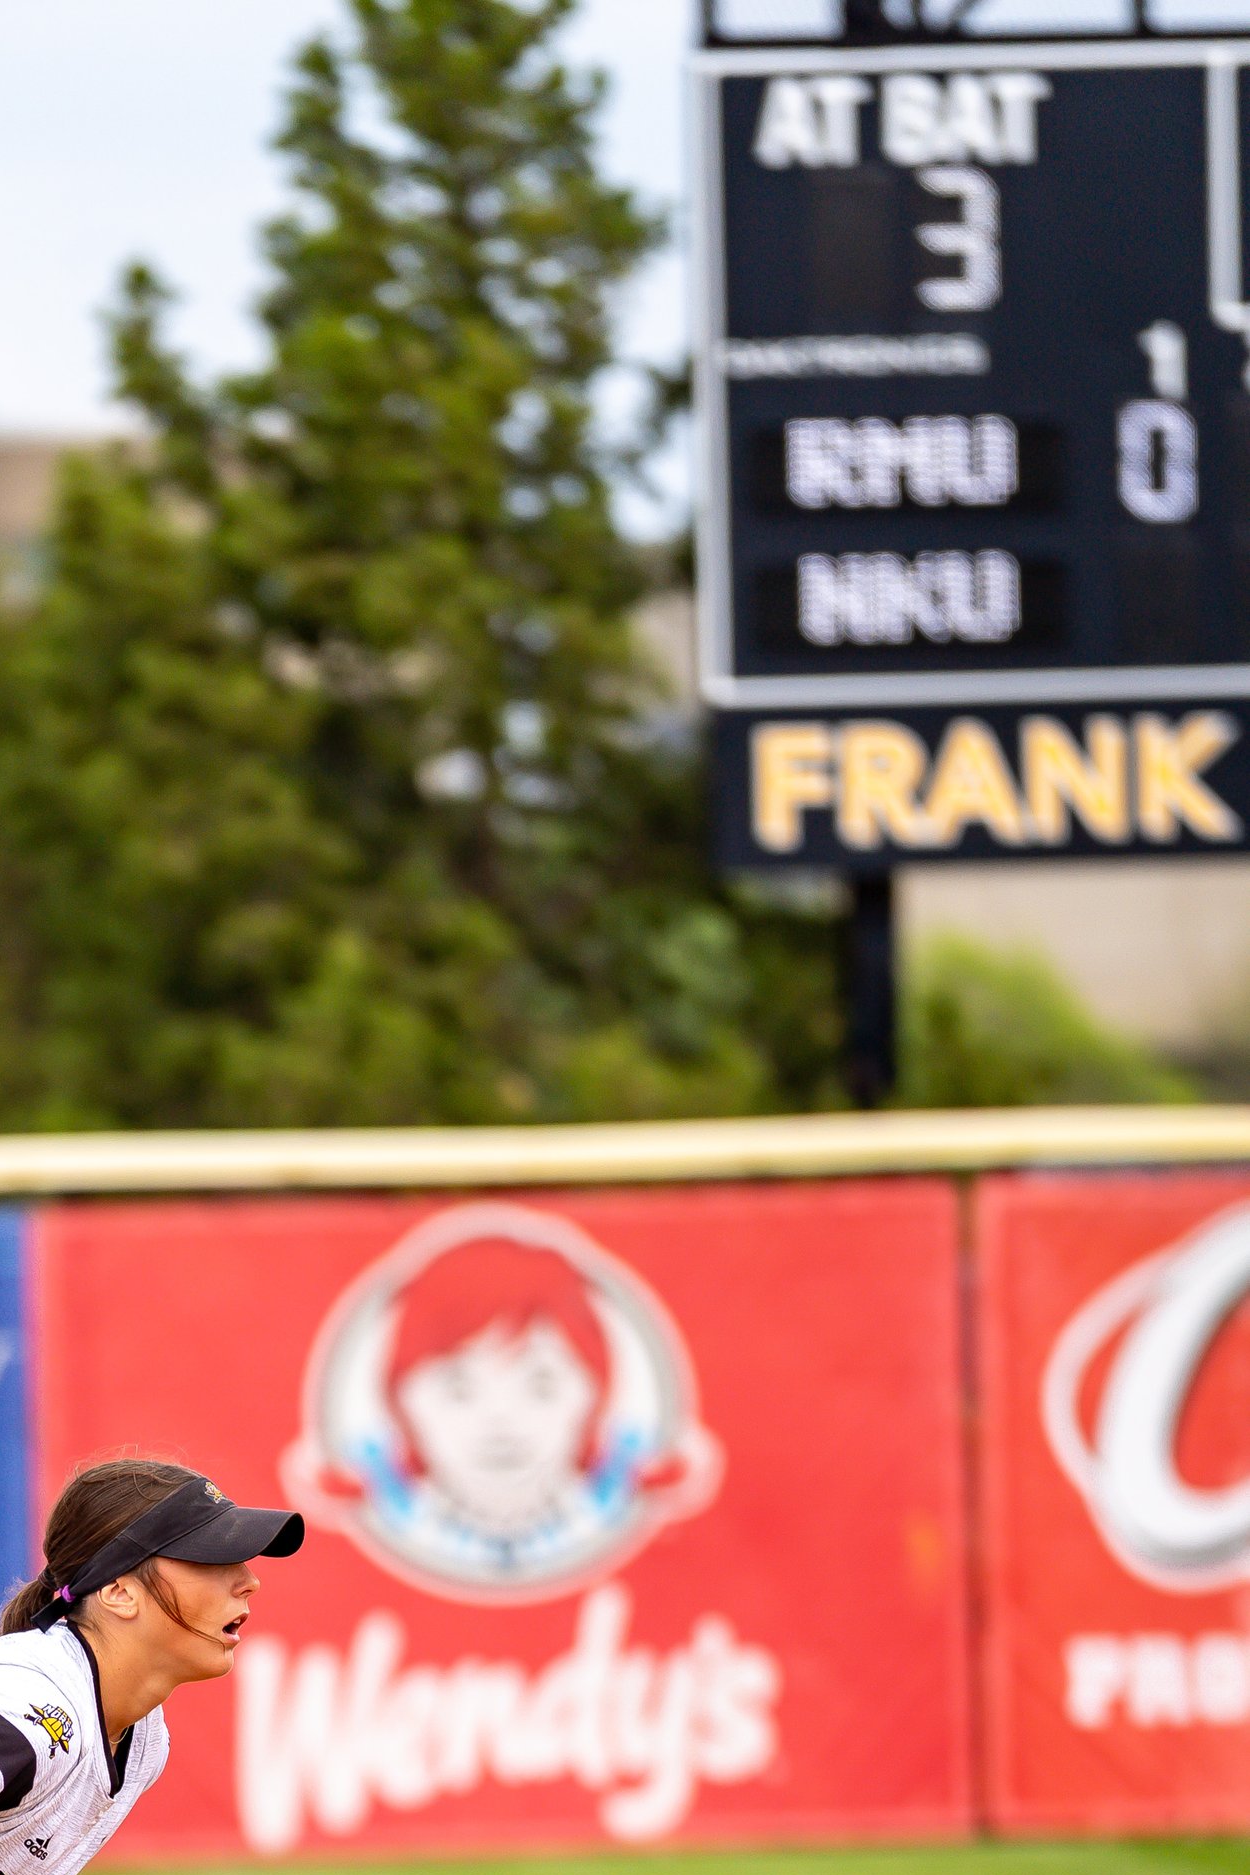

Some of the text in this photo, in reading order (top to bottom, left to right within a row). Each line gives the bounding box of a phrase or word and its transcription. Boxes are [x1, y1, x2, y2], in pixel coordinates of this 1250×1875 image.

[753, 72, 1053, 168] AT BAT
[915, 165, 1000, 311] 3
[1140, 321, 1188, 401] 1
[785, 400, 1199, 523] RMU 0
[798, 549, 1021, 645] NKU
[752, 712, 1240, 852] FRANK
[41, 1704, 75, 1742] NORSE
[235, 1582, 783, 1857] Wendy's
[24, 1838, 49, 1861] adas
